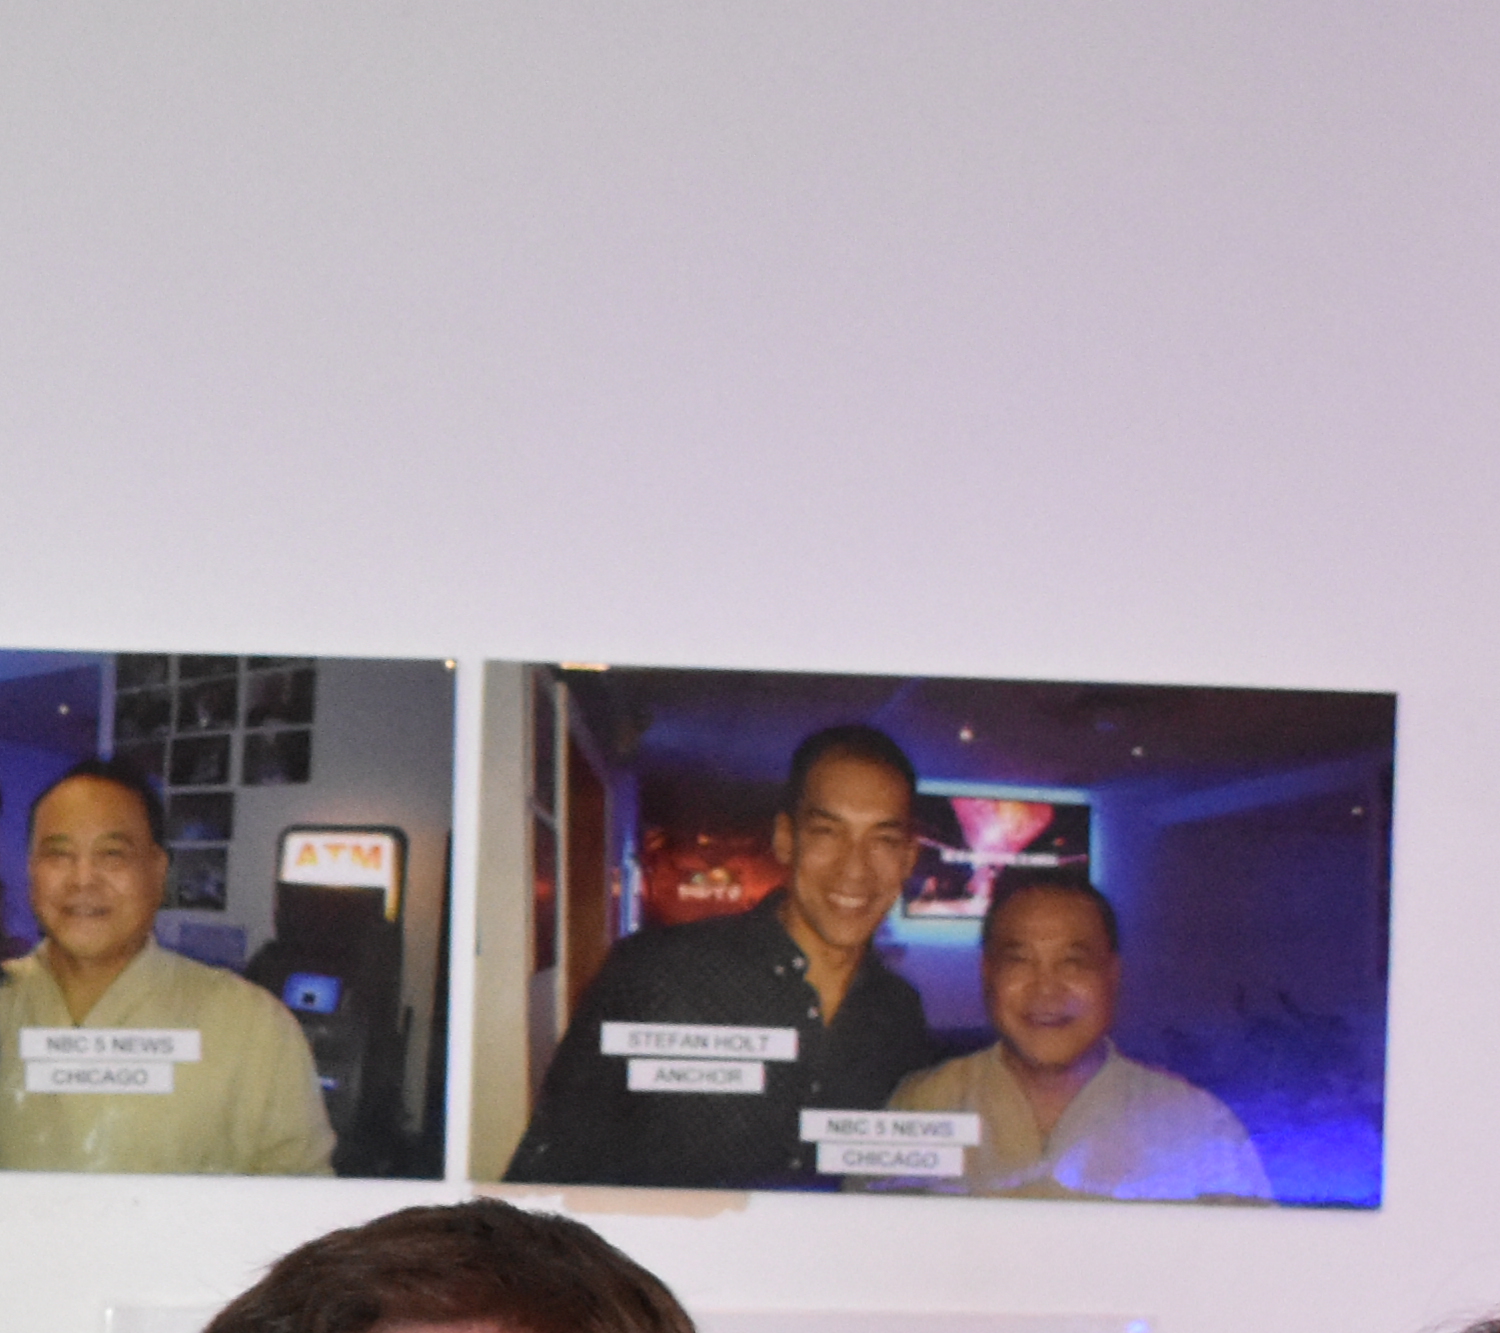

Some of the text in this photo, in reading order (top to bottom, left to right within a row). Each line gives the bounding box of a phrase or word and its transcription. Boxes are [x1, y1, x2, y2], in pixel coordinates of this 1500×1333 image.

[296, 843, 382, 870] ATM
[46, 1036, 95, 1053] NBC
[112, 1037, 175, 1055] NEWS
[627, 1034, 768, 1052] STEFAN HOLT
[52, 1068, 148, 1087] CHICAGO
[653, 1068, 742, 1084] ANCHOR
[826, 1119, 868, 1136] NBC
[891, 1120, 955, 1137] NEWS
[842, 1151, 939, 1167] CHICAGO
